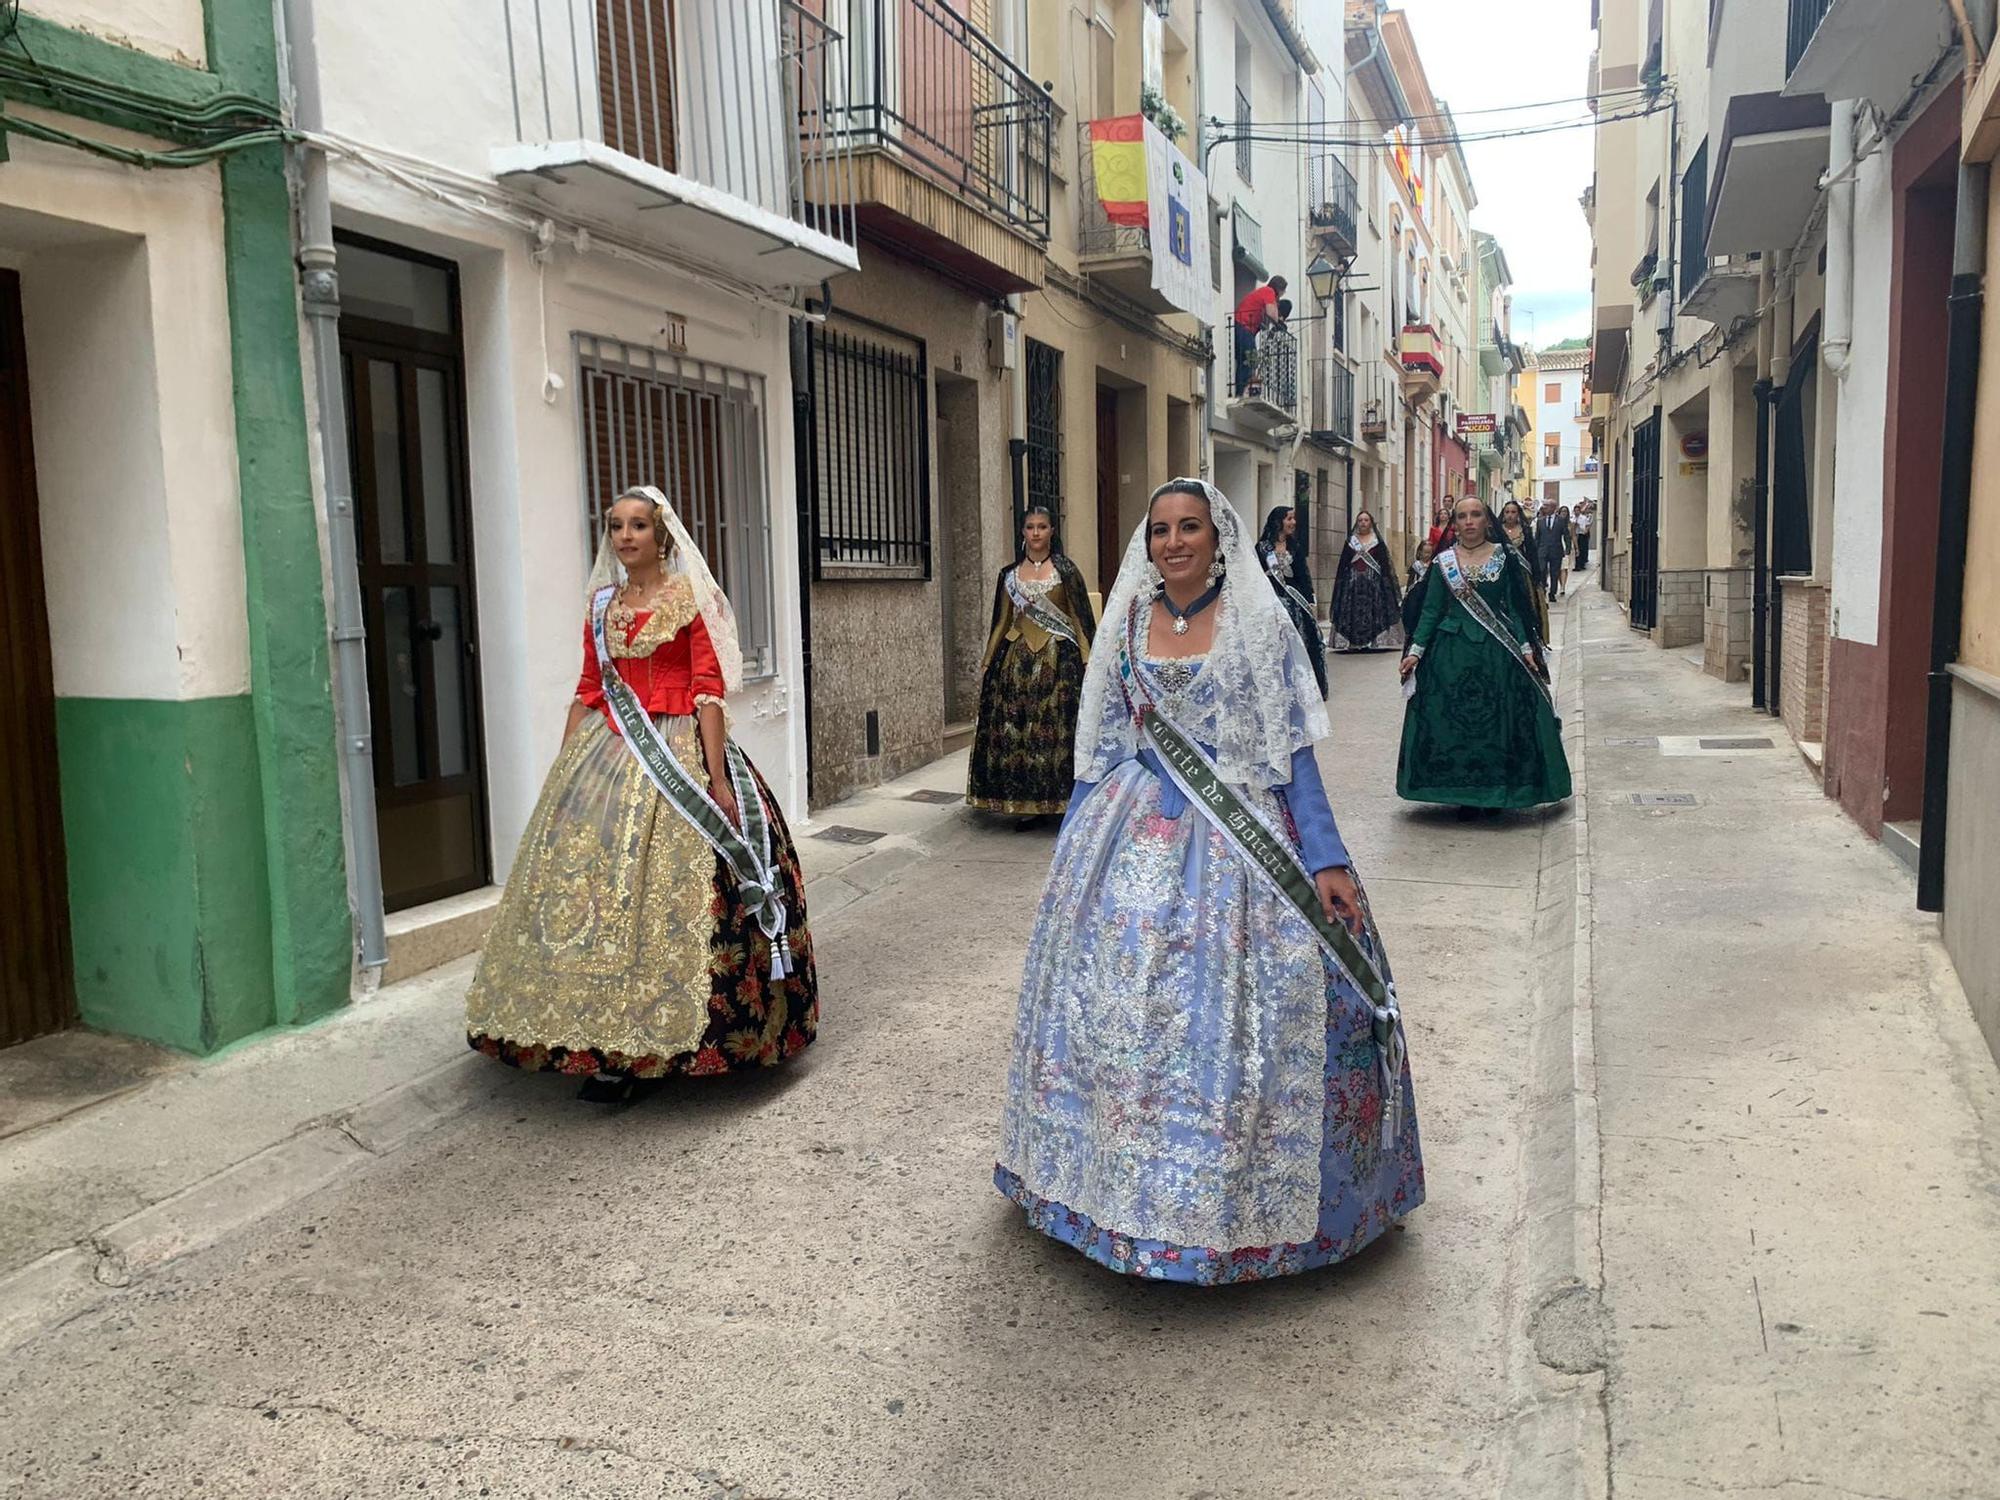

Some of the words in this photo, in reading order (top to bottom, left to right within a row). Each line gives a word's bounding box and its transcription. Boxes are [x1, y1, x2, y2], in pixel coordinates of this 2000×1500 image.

[671, 322, 685, 345] 11
[648, 747, 685, 794] Honor
[1153, 721, 1199, 779] Corte
[1201, 779, 1224, 806] de
[1225, 807, 1287, 875] Honor
